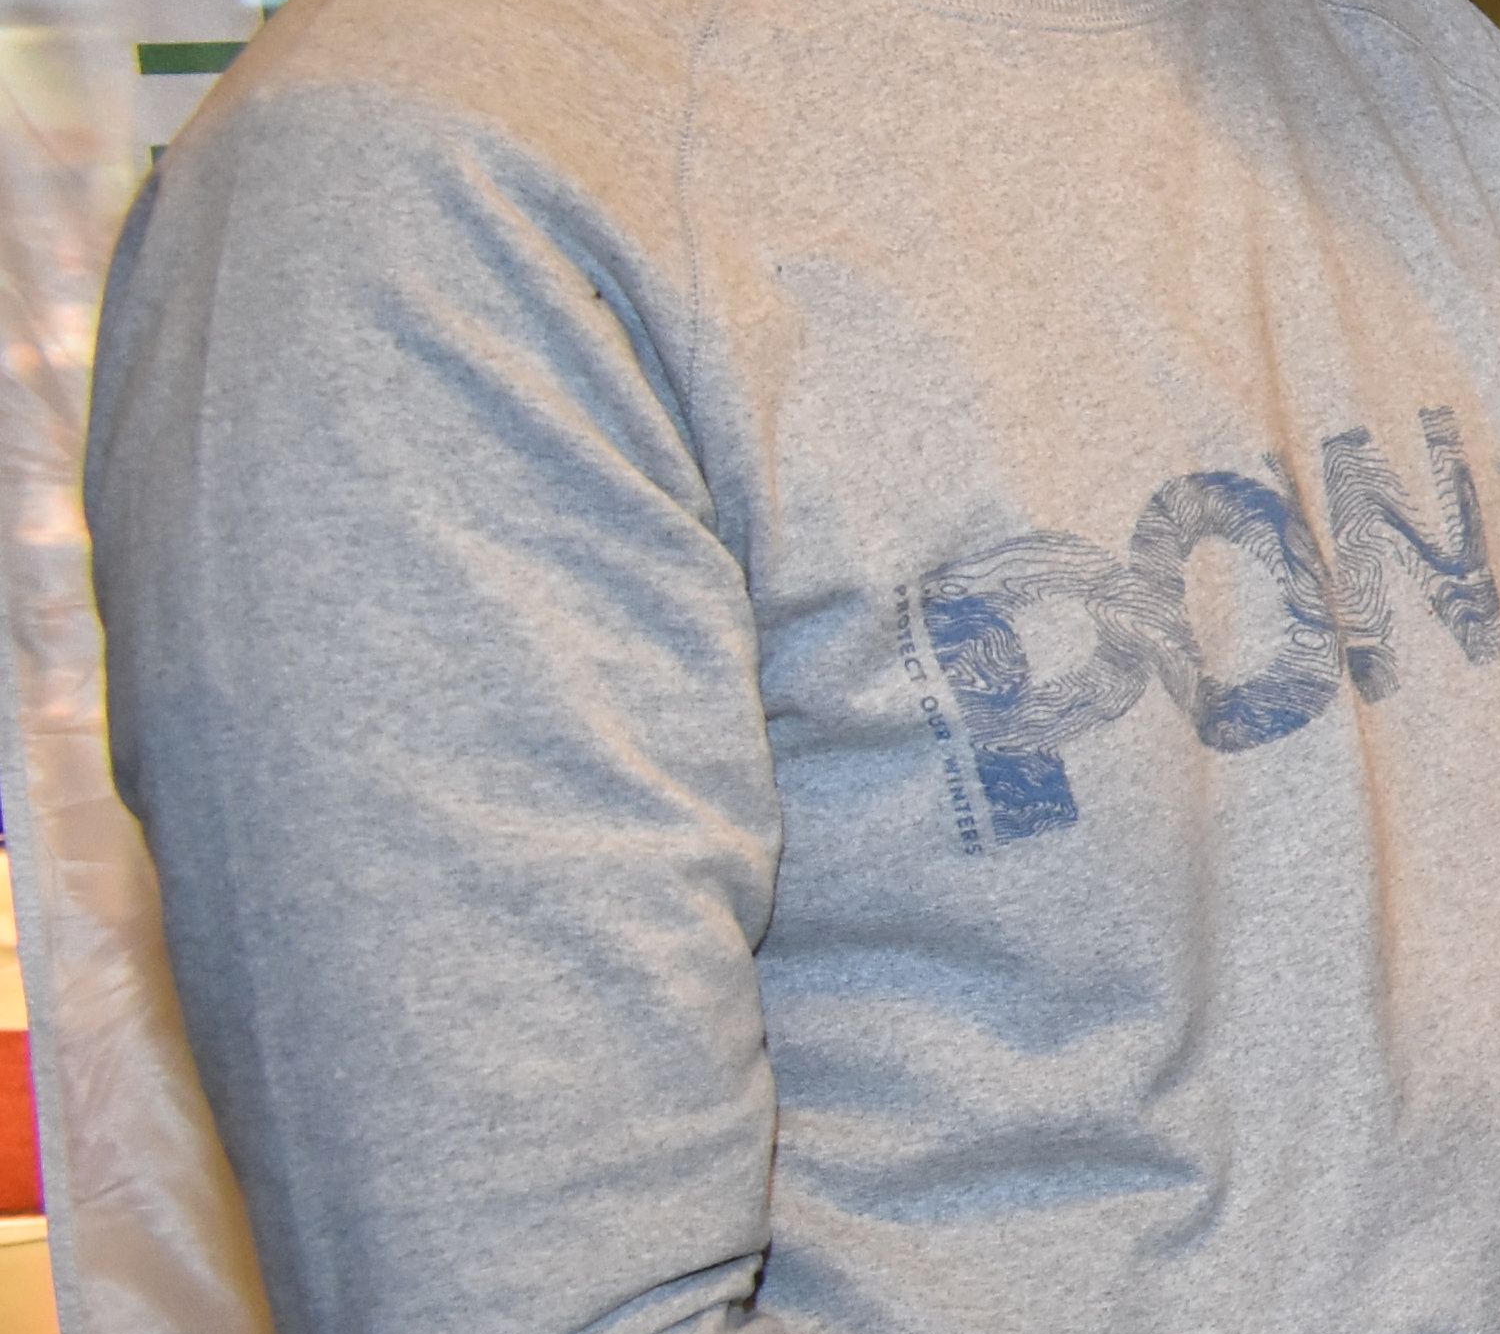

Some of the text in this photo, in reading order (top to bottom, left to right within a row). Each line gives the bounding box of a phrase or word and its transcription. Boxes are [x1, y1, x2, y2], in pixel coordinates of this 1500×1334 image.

[894, 584, 982, 855] PROTECT OUR WINTERS
